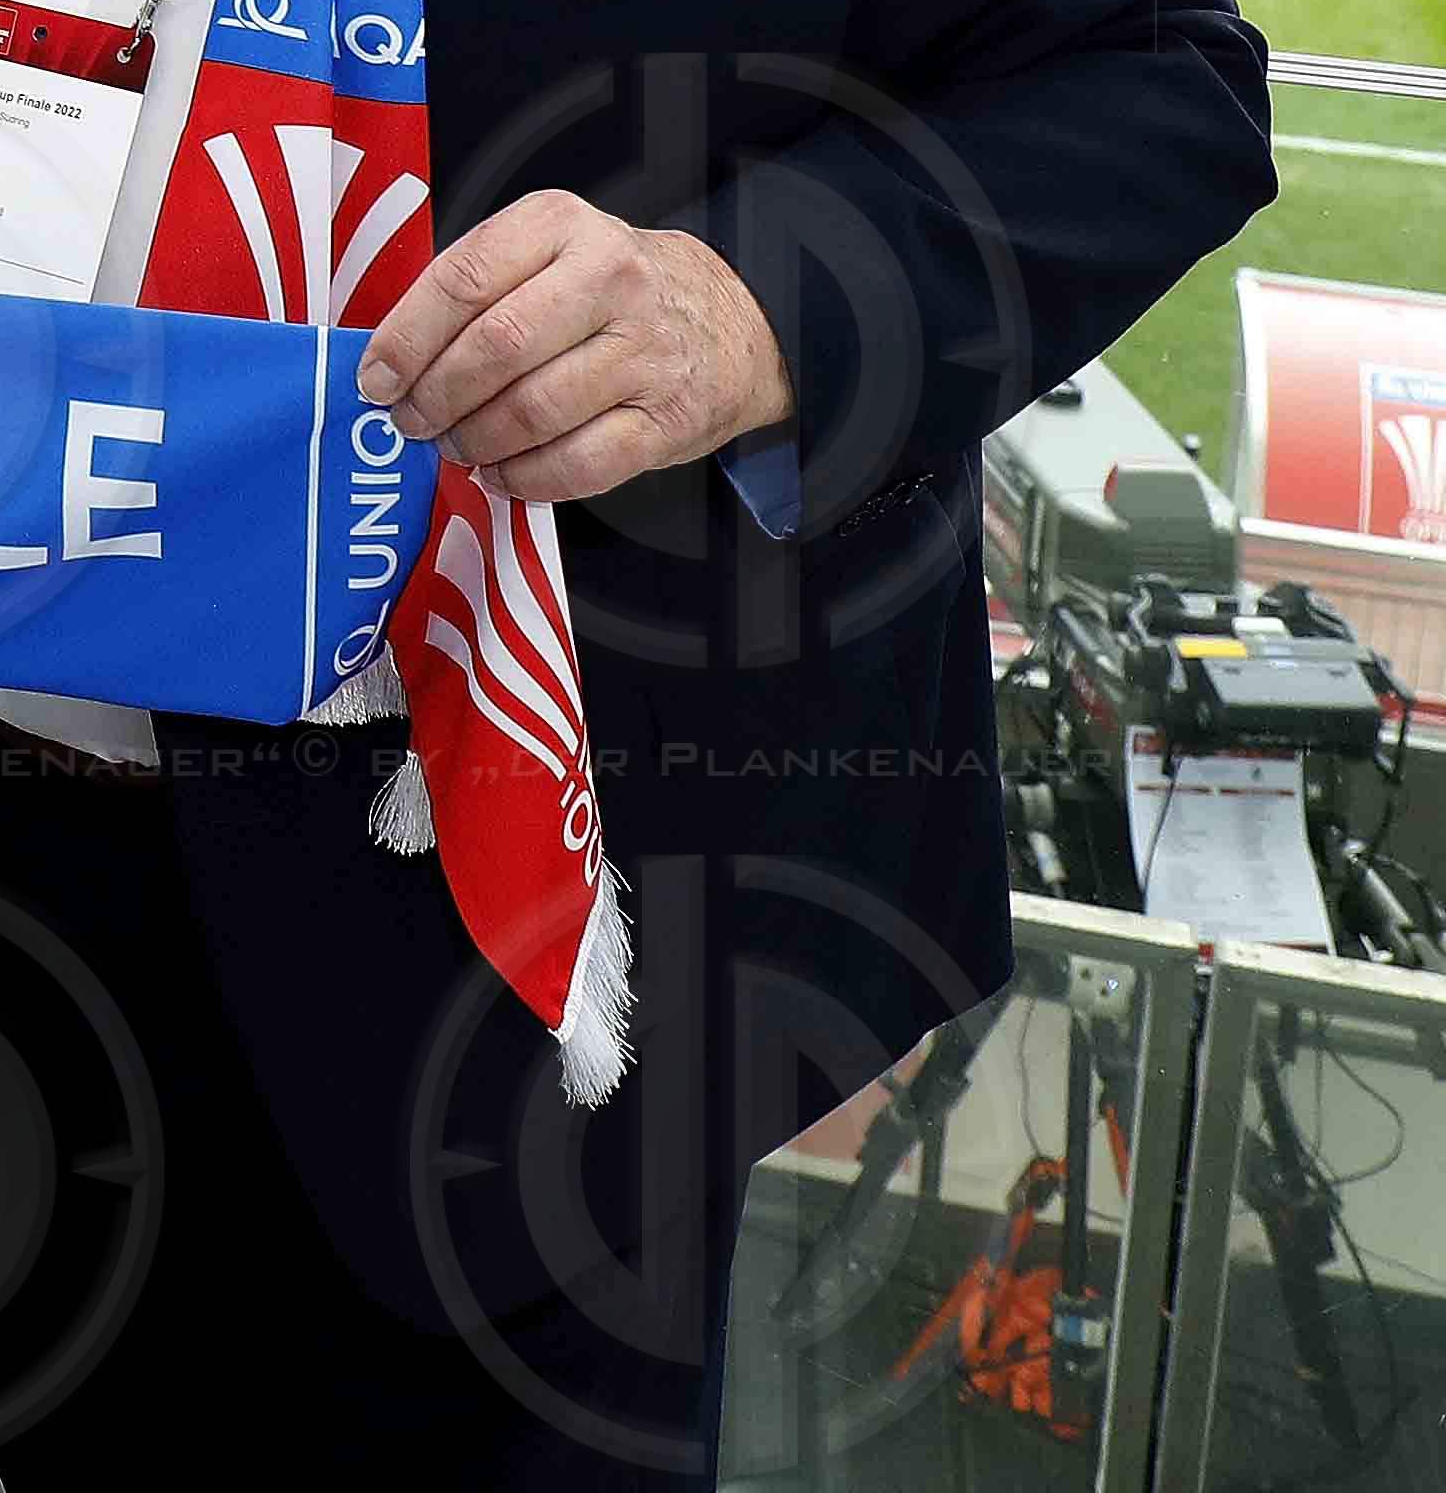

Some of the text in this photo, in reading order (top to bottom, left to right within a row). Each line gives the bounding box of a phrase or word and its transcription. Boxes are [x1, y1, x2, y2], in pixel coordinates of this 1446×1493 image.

[17, 93, 52, 113] Finale
[54, 103, 83, 120] 2022
[348, 401, 406, 591] UNIQ
